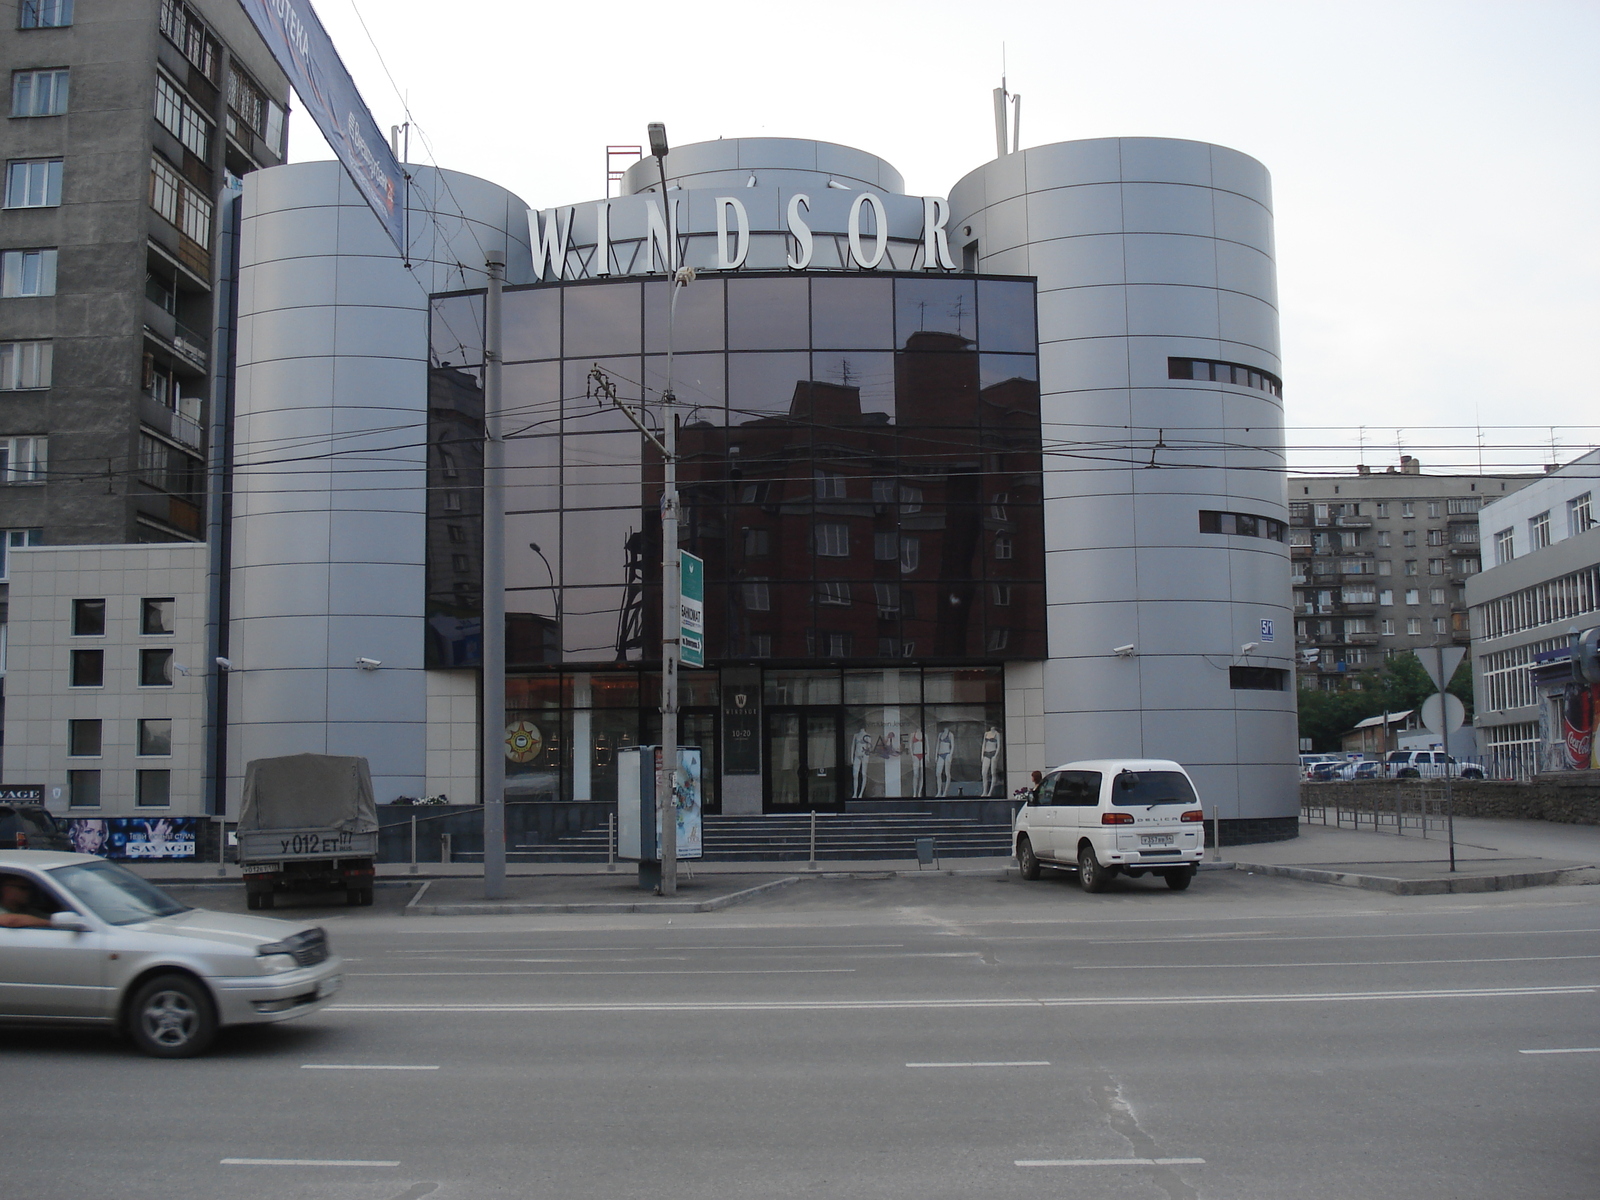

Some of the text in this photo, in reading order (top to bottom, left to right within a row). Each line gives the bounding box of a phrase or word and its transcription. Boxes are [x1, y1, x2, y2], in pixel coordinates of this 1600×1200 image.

[271, 0, 309, 63] ОТЕКА
[526, 192, 957, 281] WINDSOR
[1262, 620, 1273, 634] 5/1
[732, 729, 751, 738] 10-20
[131, 844, 194, 853] SAVAGE
[293, 834, 319, 854] 012
[322, 839, 339, 852] ЕТ
